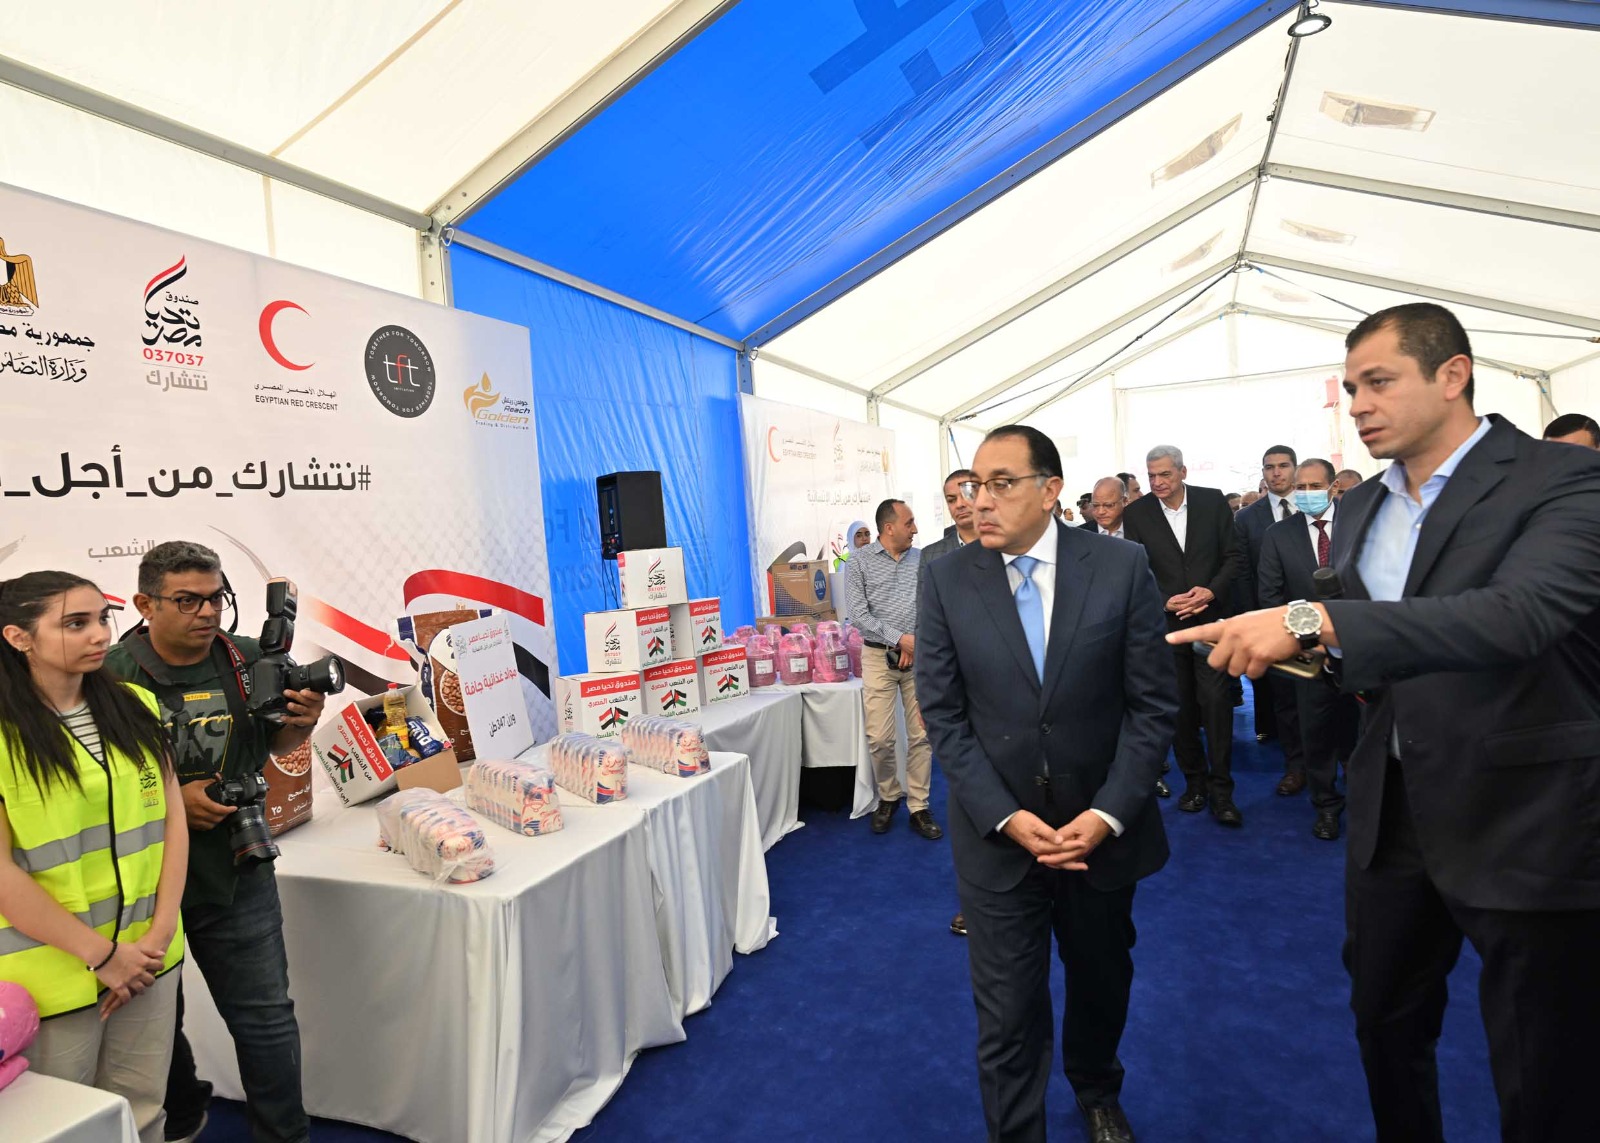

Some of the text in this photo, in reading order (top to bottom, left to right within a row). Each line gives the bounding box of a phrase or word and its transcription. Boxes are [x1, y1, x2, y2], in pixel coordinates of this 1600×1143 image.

[165, 291, 199, 305] صندوق
[22, 322, 95, 352] جمهورية
[143, 347, 204, 366] 037037
[369, 331, 390, 359] TOGETHER
[407, 335, 431, 372] TOMORROW
[146, 370, 208, 392] نتشارك
[255, 394, 338, 411] EGYPTIAN RED CRESCENT
[504, 405, 530, 414] Reach
[477, 409, 529, 424] Golden
[707, 651, 744, 664] صندوق تحيا مصر
[649, 664, 694, 678] صندوق تحيا مصر
[465, 667, 518, 695] مواد غذائية جافة
[585, 679, 637, 694] صندوق تحيا مصر
[669, 678, 686, 687] الشعب
[608, 694, 628, 704] الشعب
[506, 713, 517, 728] وزن
[346, 714, 385, 774] صندوق تحيا مصر
[351, 747, 368, 771] الشعب
[330, 772, 344, 793] الشعب
[364, 770, 373, 781] من
